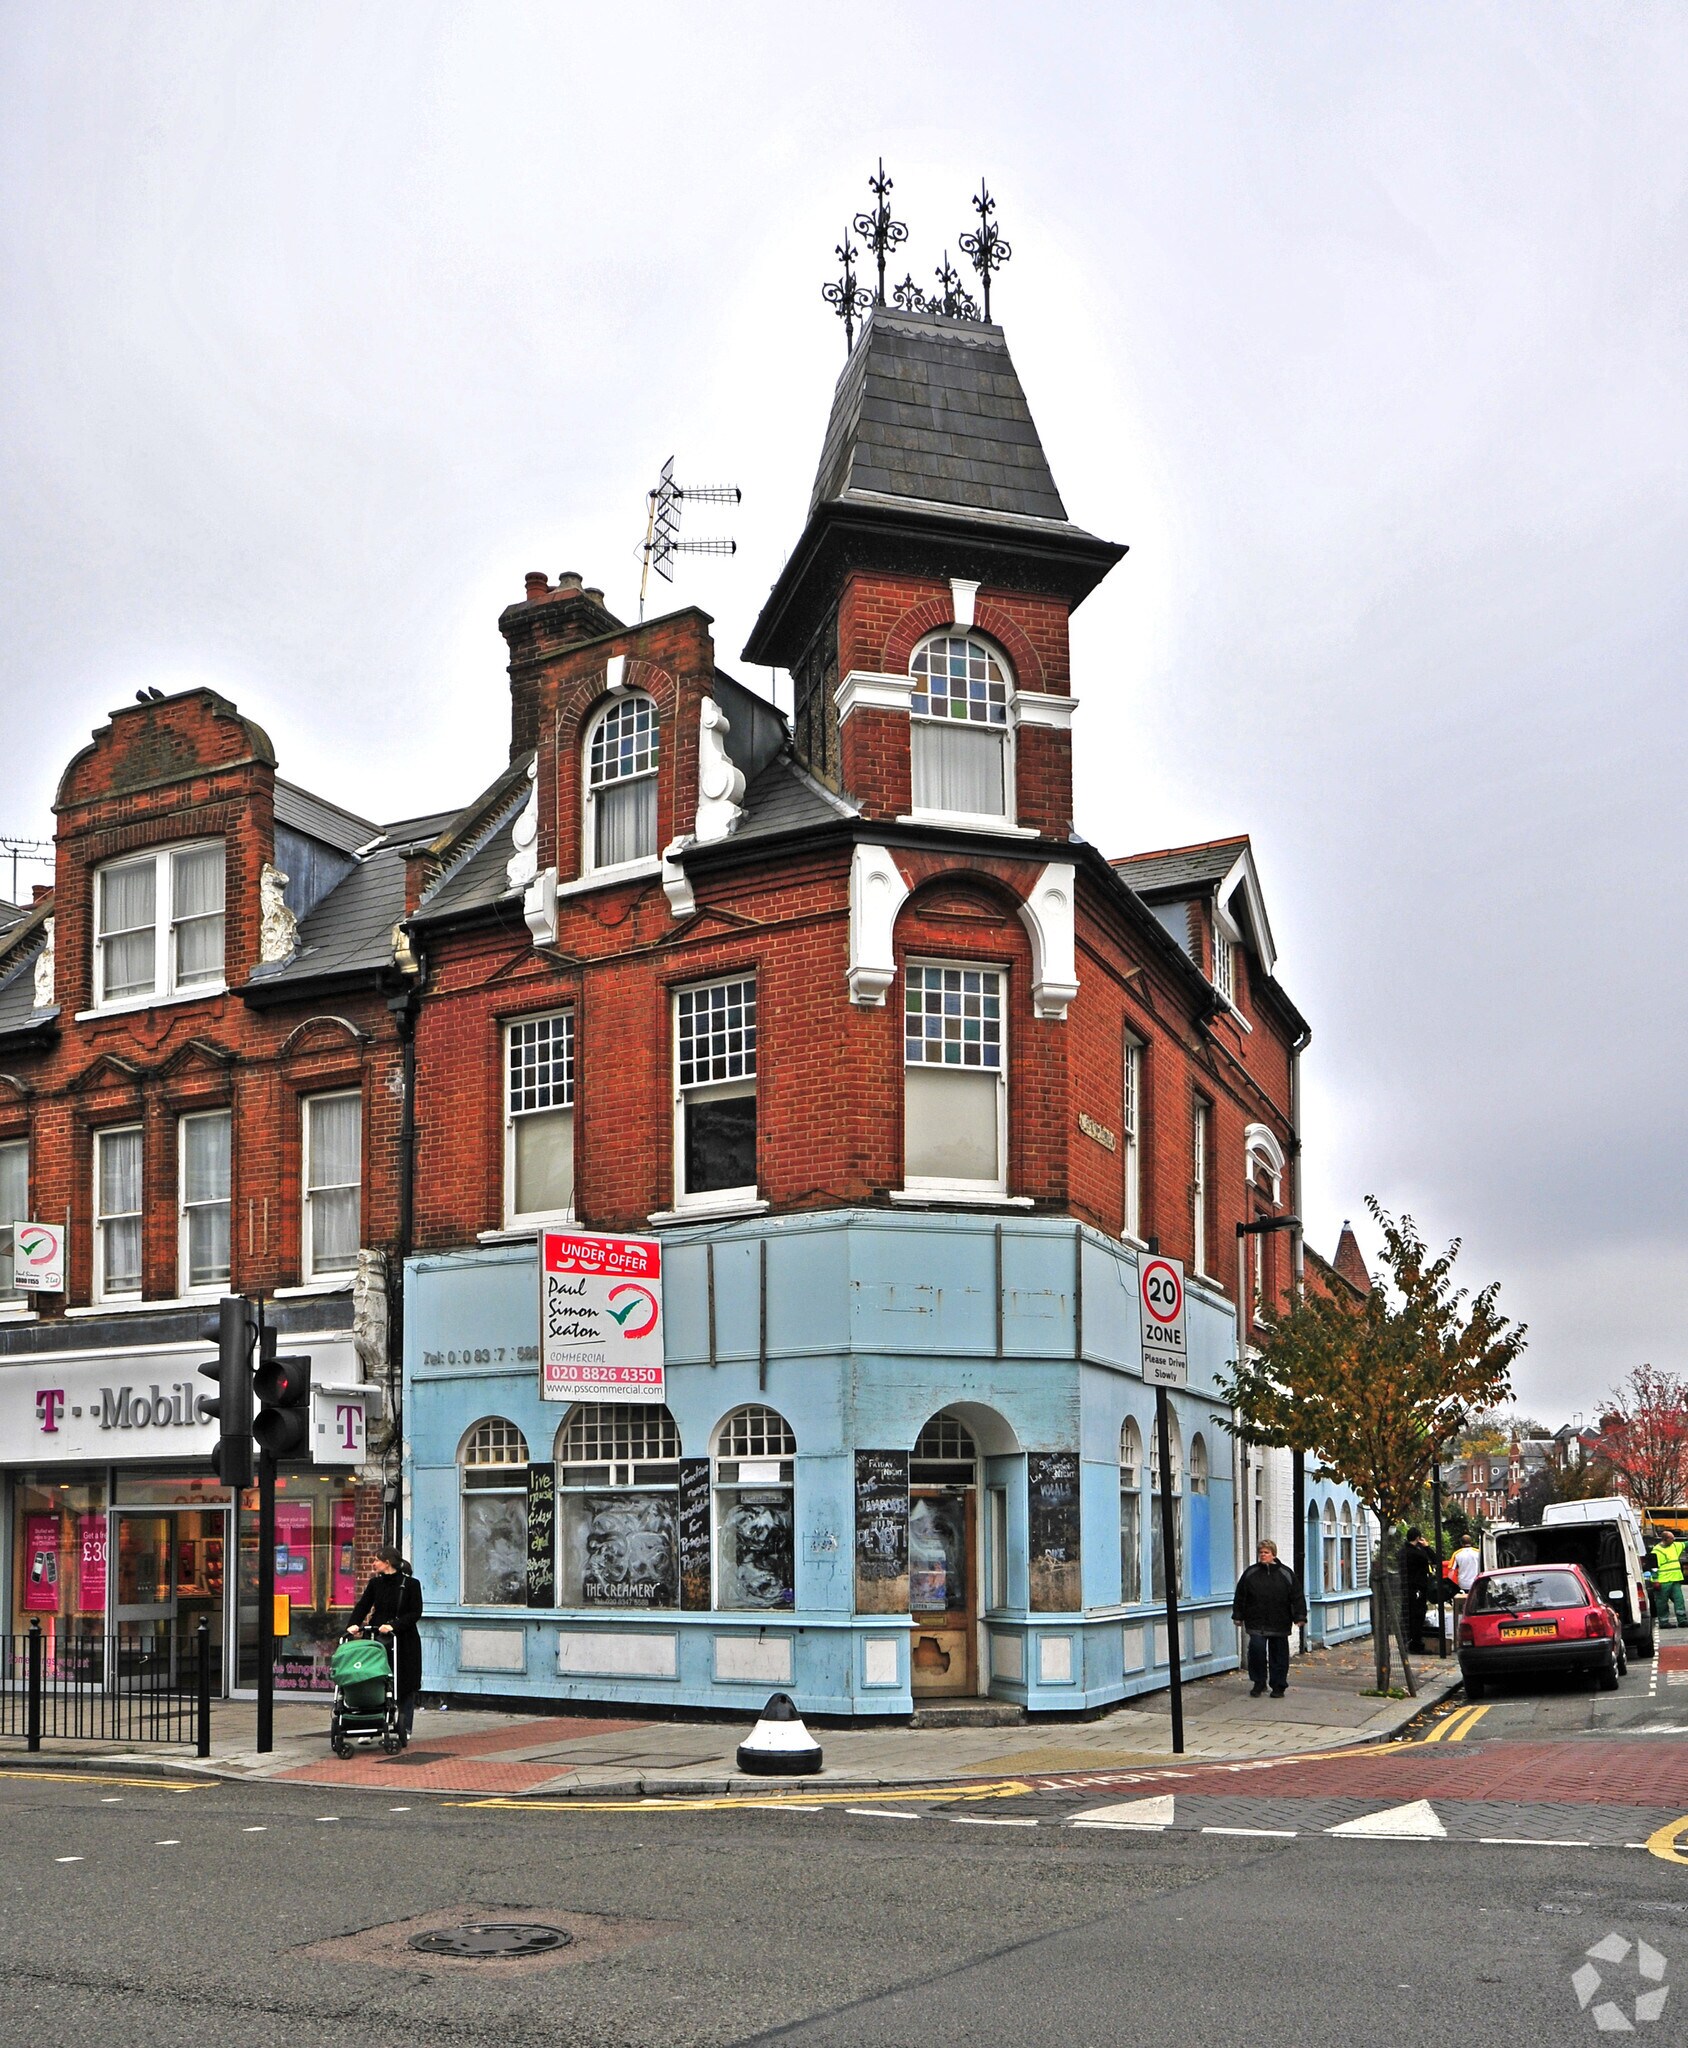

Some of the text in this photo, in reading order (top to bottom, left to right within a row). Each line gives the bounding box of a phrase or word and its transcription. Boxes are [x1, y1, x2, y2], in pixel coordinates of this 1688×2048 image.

[561, 1242, 605, 1262] UNDER
[609, 1252, 648, 1271] OFFER
[548, 1276, 588, 1298] Paul
[1148, 1277, 1176, 1305] 20
[548, 1298, 600, 1318] Simon
[548, 1318, 600, 1338] Seaton
[1146, 1325, 1182, 1345] ZONE
[550, 1351, 606, 1364] COMMERCIAL
[1144, 1353, 1186, 1369] Please Drive
[551, 1366, 656, 1382] 020 8826 4350
[1154, 1368, 1178, 1382] Slowly
[546, 1384, 663, 1395] www.psscommercial.com
[83, 1531, 94, 1540] Get
[586, 1582, 658, 1598] THE CREAMERY
[1532, 1625, 1555, 1635] MNE
